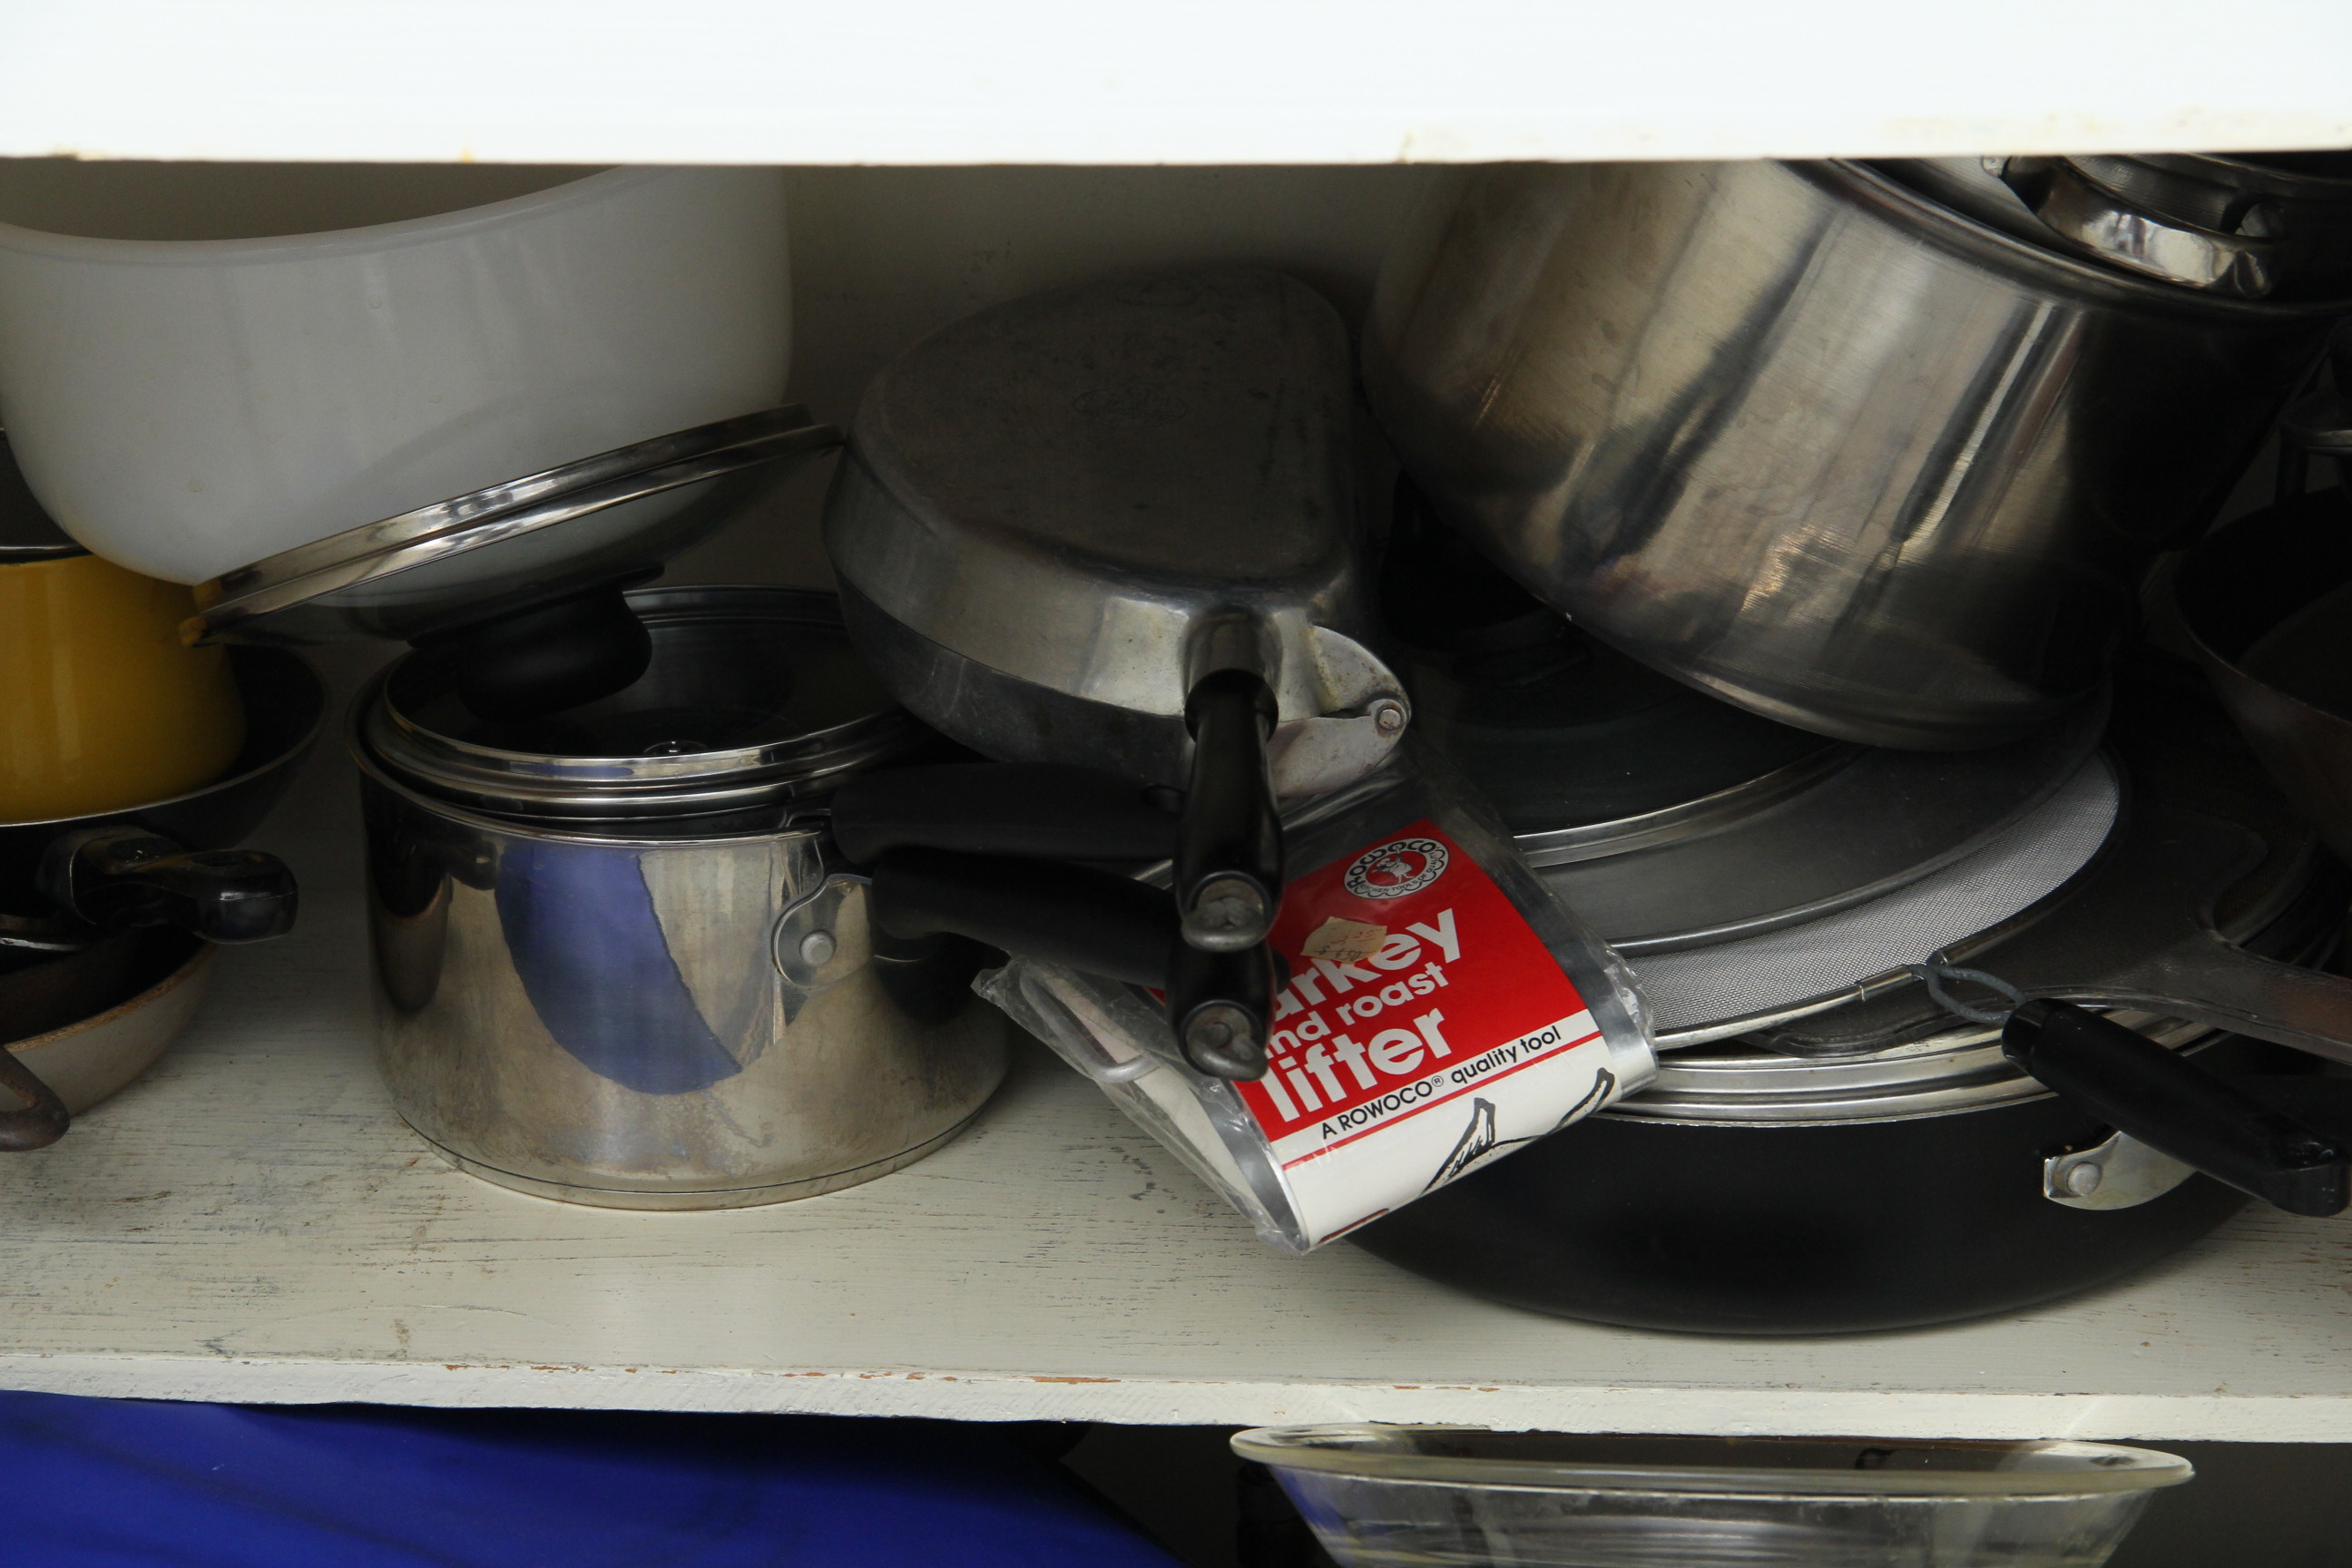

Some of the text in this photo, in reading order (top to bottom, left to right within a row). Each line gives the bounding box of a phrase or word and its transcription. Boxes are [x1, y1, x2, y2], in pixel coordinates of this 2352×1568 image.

[1392, 880, 1418, 891] TOOLS
[1264, 961, 1449, 1059] nd roast
[1275, 908, 1461, 1022] urkey
[1260, 1007, 1452, 1122] lifter
[1322, 1122, 1338, 1139] A
[1452, 1044, 1516, 1083] quality
[1520, 1025, 1562, 1054] tool
